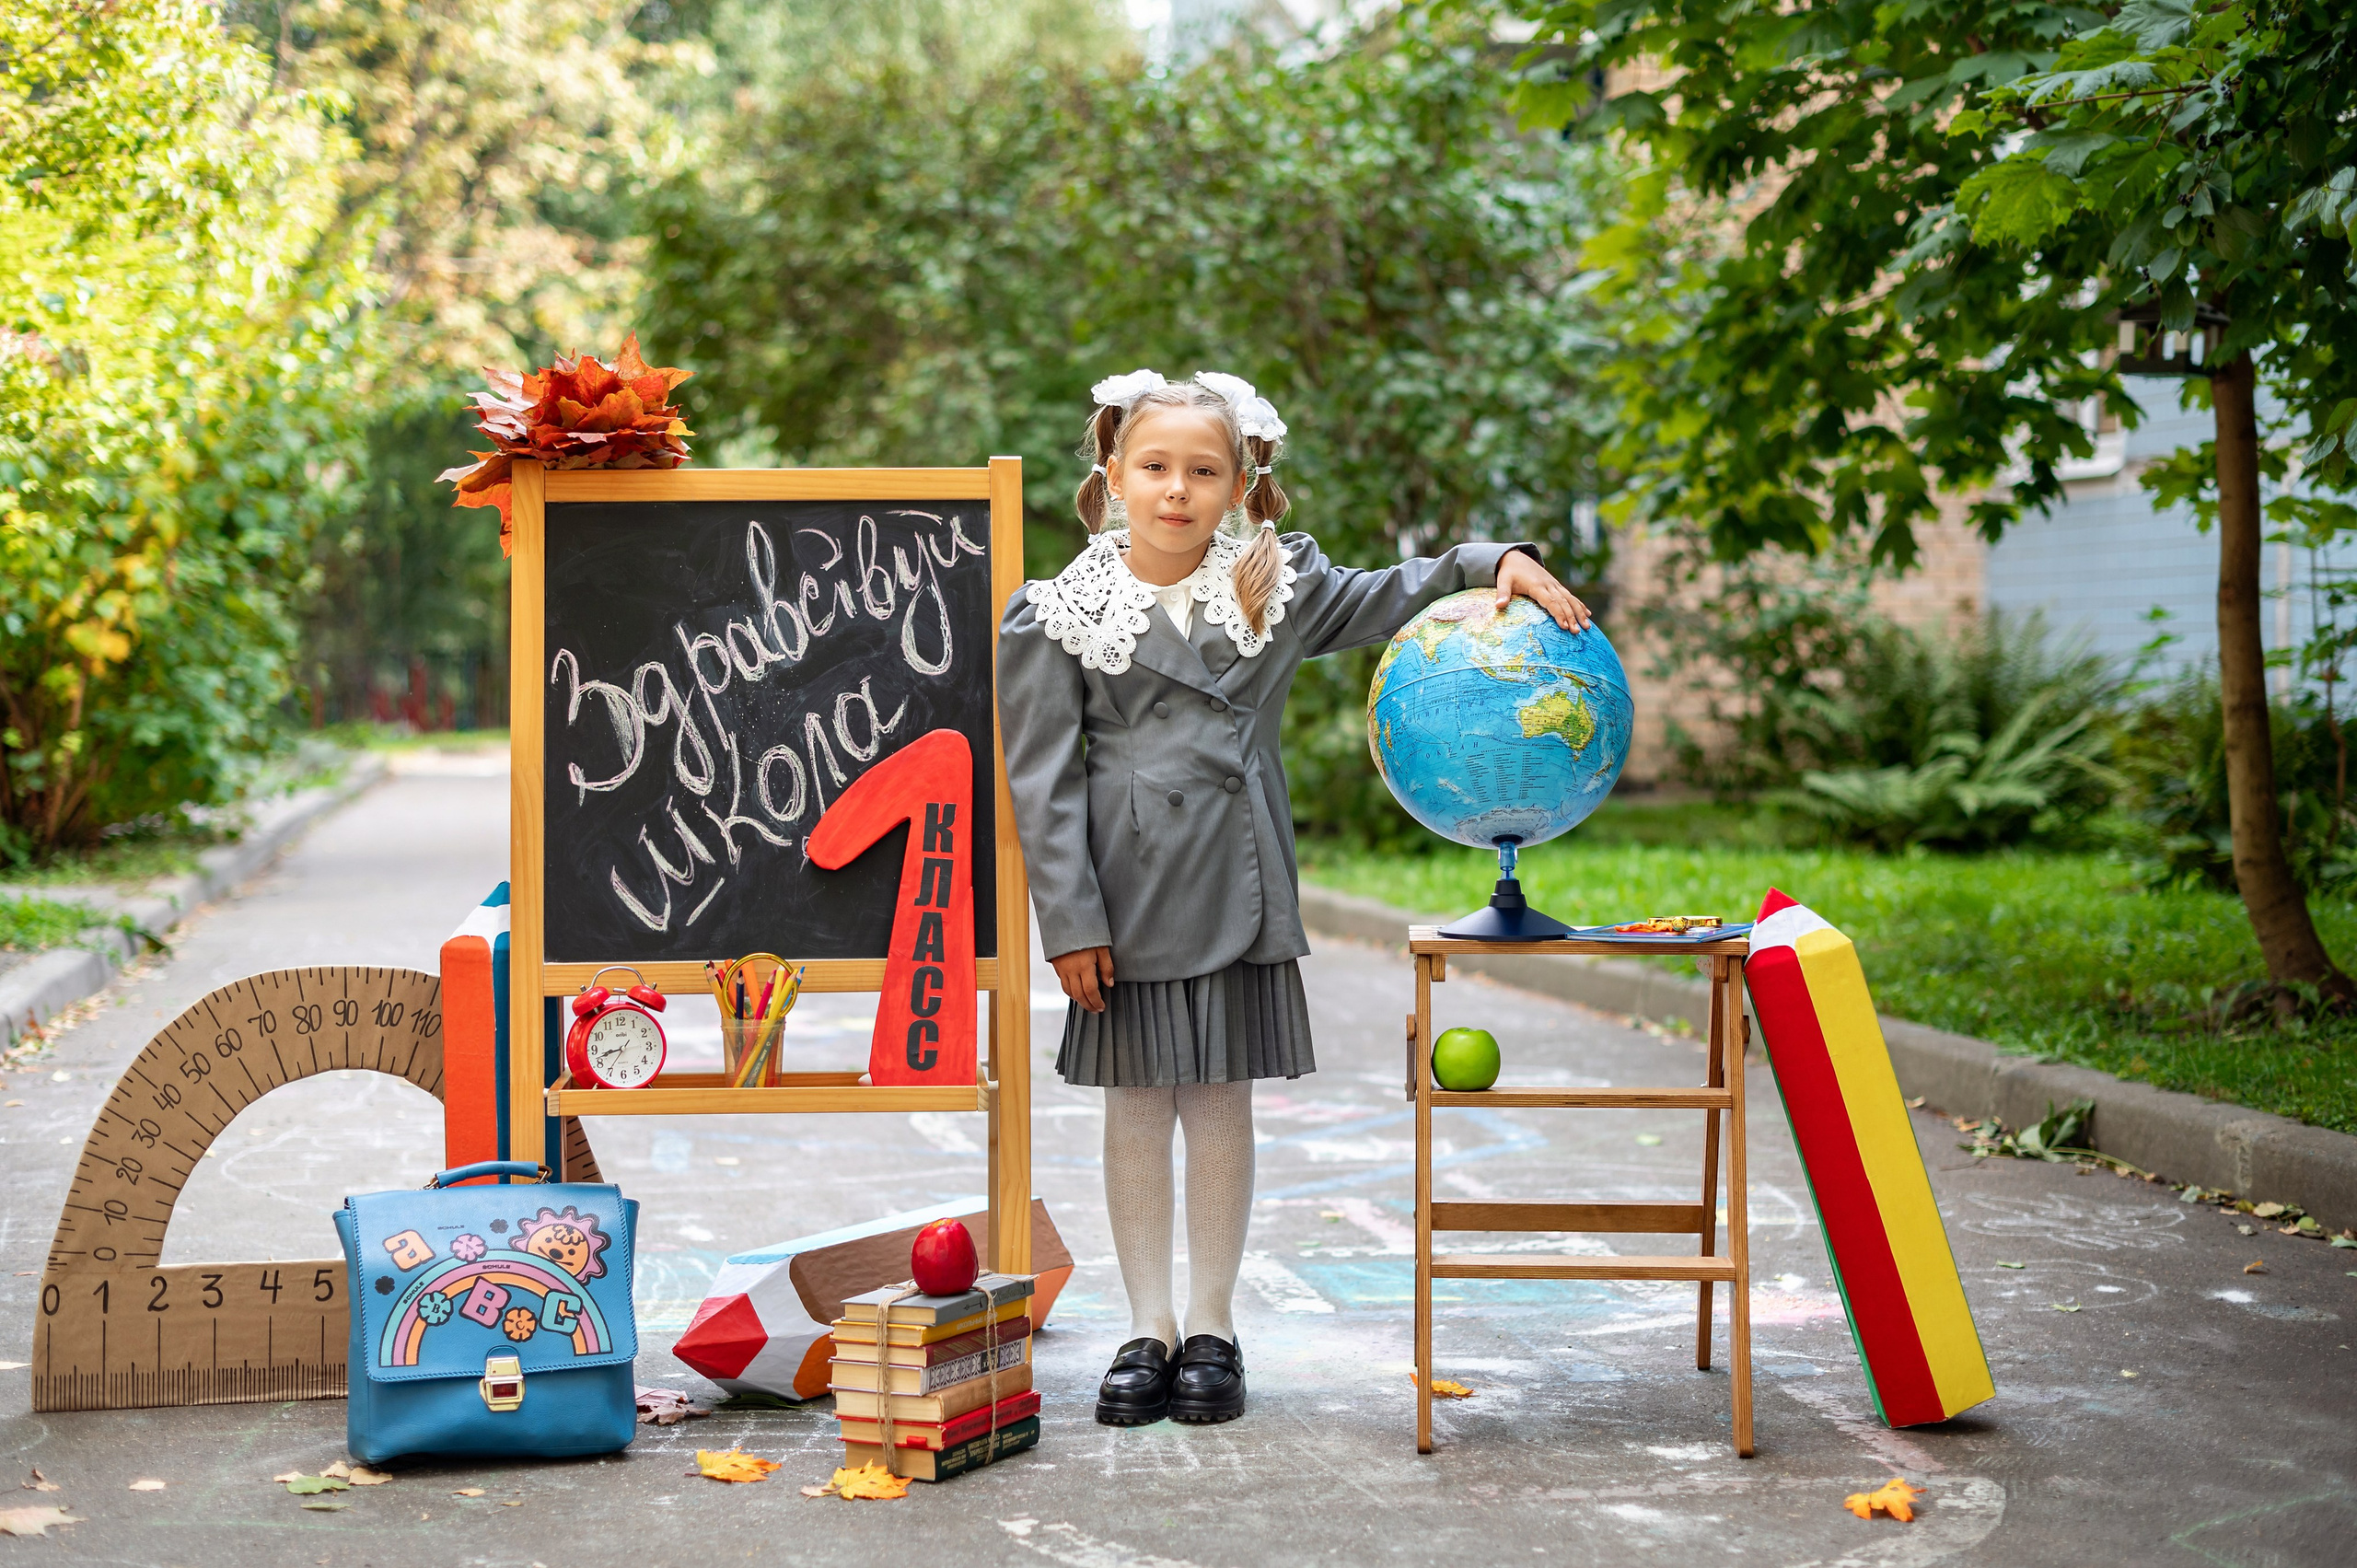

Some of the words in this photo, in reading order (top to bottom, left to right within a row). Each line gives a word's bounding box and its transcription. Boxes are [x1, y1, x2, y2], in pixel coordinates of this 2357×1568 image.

[807, 728, 977, 1086] 1
[907, 802, 957, 1072] КЛАСС
[292, 1005, 323, 1035] 80
[332, 1002, 359, 1028] 90
[371, 1001, 403, 1028] 100
[411, 1007, 442, 1038] 110
[603, 1021, 613, 1031] 11
[615, 1016, 626, 1027] 12
[632, 1019, 636, 1028] 1
[248, 1015, 278, 1038] 70
[594, 1032, 604, 1041] 10
[641, 1028, 648, 1038] 2
[215, 1028, 244, 1058] 60
[591, 1044, 598, 1055] 9
[645, 1041, 653, 1051] 3
[180, 1051, 212, 1084] 50
[597, 1059, 604, 1069] 8
[633, 1065, 640, 1075] 5
[641, 1055, 648, 1065] 4
[608, 1068, 614, 1077] 7
[620, 1070, 627, 1080] 6
[154, 1083, 181, 1112] 40
[132, 1118, 162, 1149] 30
[115, 1156, 143, 1185] 20
[102, 1199, 129, 1226] 10
[93, 1246, 117, 1261] 0
[383, 1229, 436, 1272] a
[42, 1283, 60, 1316] 0
[93, 1280, 110, 1313] 1
[147, 1276, 169, 1312] 2
[202, 1274, 224, 1308] 3
[260, 1270, 283, 1304] 4
[314, 1269, 333, 1301] 5
[402, 1281, 425, 1305] SCHULE
[459, 1276, 512, 1330] B
[432, 1303, 441, 1314] B
[540, 1290, 584, 1335] C
[516, 1320, 525, 1330] C
